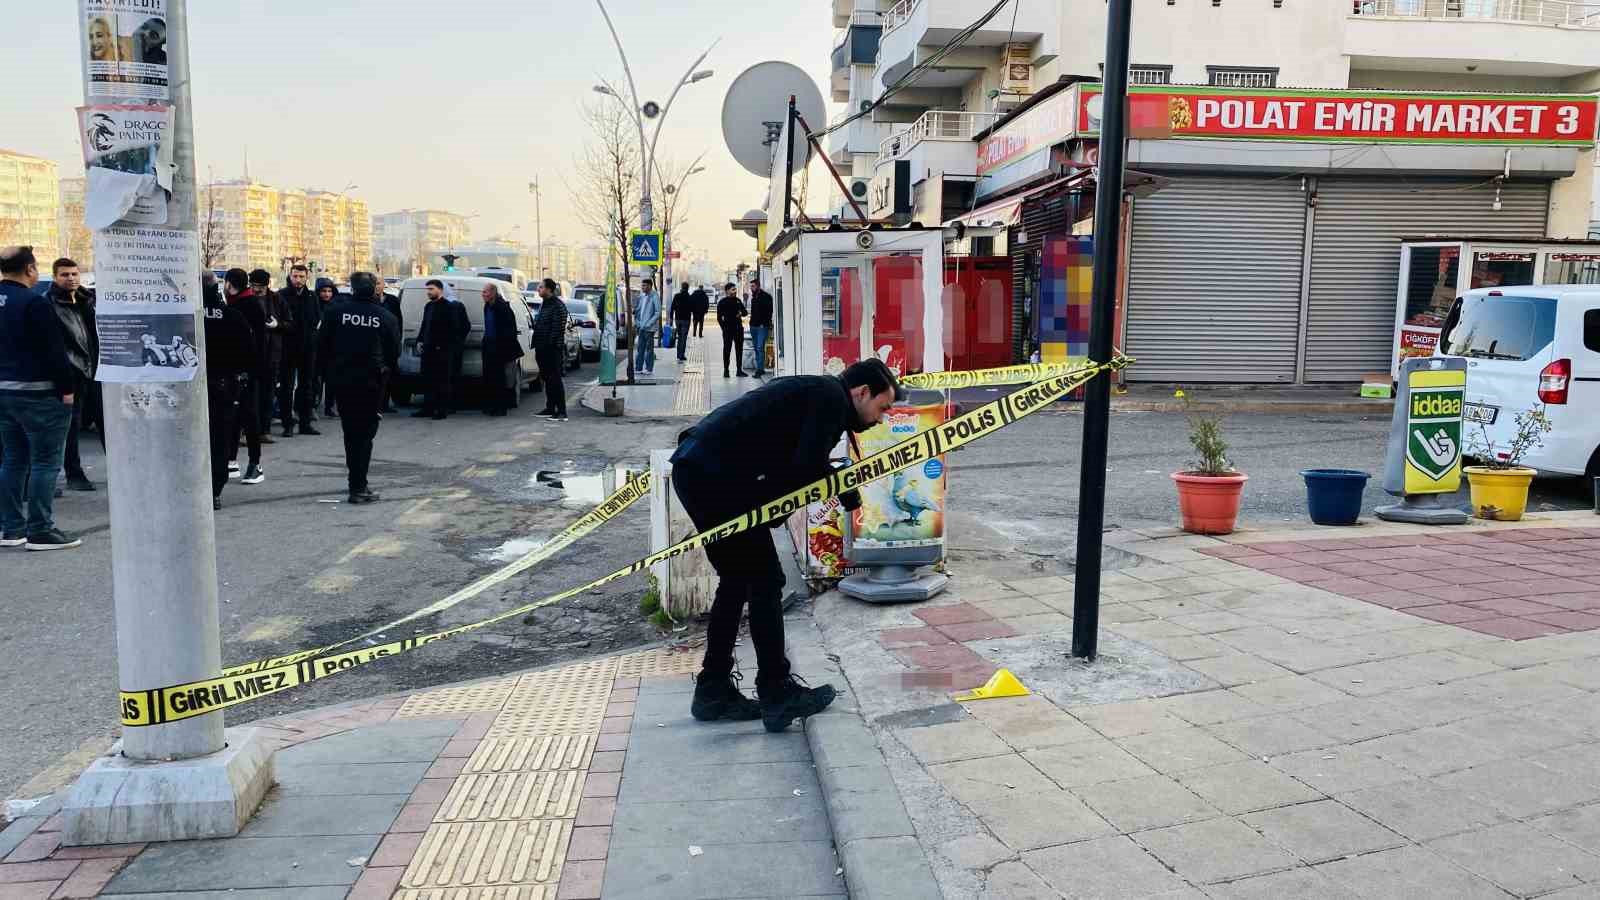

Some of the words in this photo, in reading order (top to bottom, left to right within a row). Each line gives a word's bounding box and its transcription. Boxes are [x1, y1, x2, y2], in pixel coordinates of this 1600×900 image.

[1196, 99, 1305, 131] POLAT
[1314, 101, 1398, 133] EMİR
[1406, 104, 1548, 135] MARKET
[1556, 105, 1579, 135] 3
[104, 291, 128, 301] 0506
[131, 292, 151, 302] 544
[155, 293, 170, 303] 20
[173, 294, 187, 303] 58
[342, 312, 381, 328] POLİS
[1412, 394, 1461, 417] iddaa
[169, 671, 291, 714] GİRİLMEZ
[843, 442, 923, 488] GİRİLMEZ
[946, 409, 997, 445] POLİS
